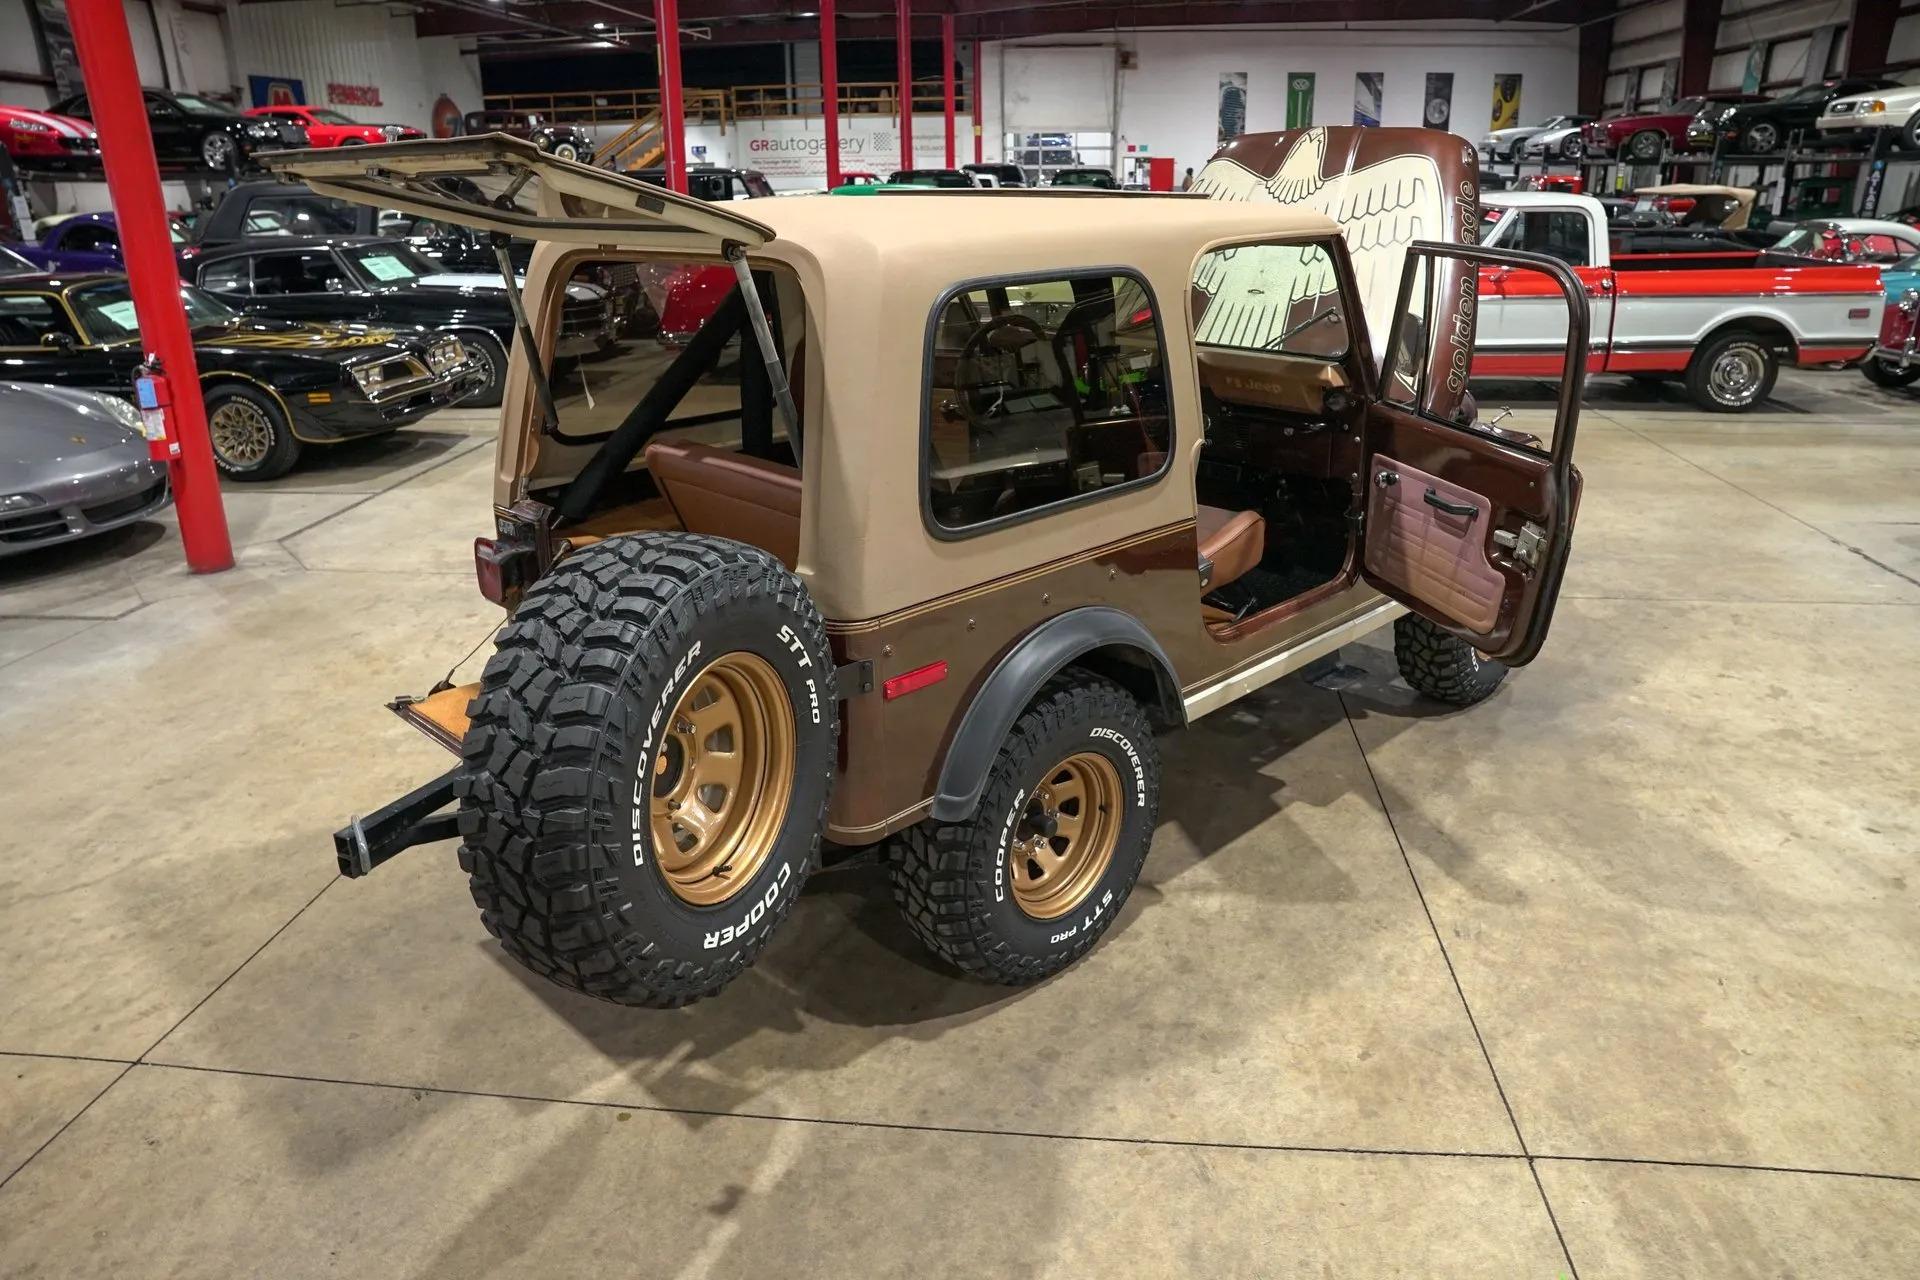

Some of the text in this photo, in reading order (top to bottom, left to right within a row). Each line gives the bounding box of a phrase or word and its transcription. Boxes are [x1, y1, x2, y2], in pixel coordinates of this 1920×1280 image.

[750, 137, 865, 155] GRautogaery
[1865, 170, 1881, 210] ATLAS
[1447, 276, 1476, 395] golden
[776, 625, 820, 723] STT PRO
[632, 640, 702, 867] DISCOVERER
[1089, 727, 1145, 807] DISCOVERER
[995, 788, 1026, 902] COOPER
[703, 862, 791, 949] COOPER
[1050, 889, 1113, 944] STT PRO
